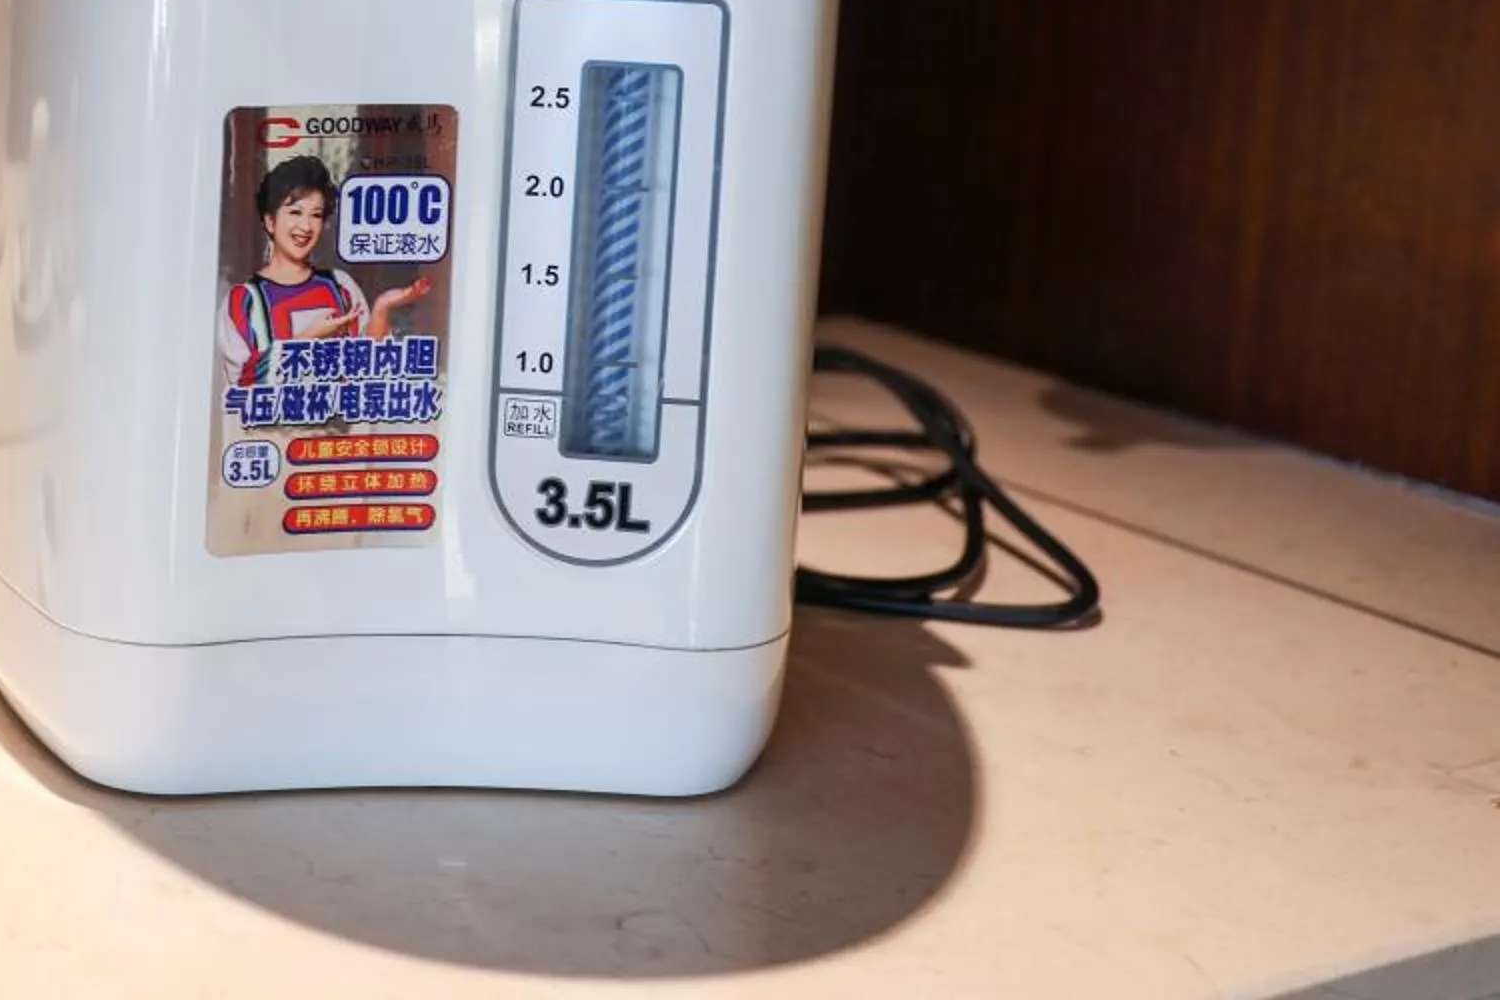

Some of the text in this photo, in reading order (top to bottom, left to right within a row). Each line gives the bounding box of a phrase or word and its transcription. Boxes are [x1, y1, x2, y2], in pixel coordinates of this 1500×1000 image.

[529, 85, 571, 109] 2.5
[305, 116, 400, 135] GOODWAY
[525, 175, 565, 198] 2.0
[349, 233, 440, 255] 保证滚水
[521, 263, 559, 286] 1.5
[280, 338, 437, 379] 不锈钢内胆
[515, 351, 554, 374] 1.0
[509, 402, 553, 422] 加水
[507, 422, 549, 436] REFILL
[229, 459, 275, 482] 3.5L
[534, 475, 651, 533] 3.5L
